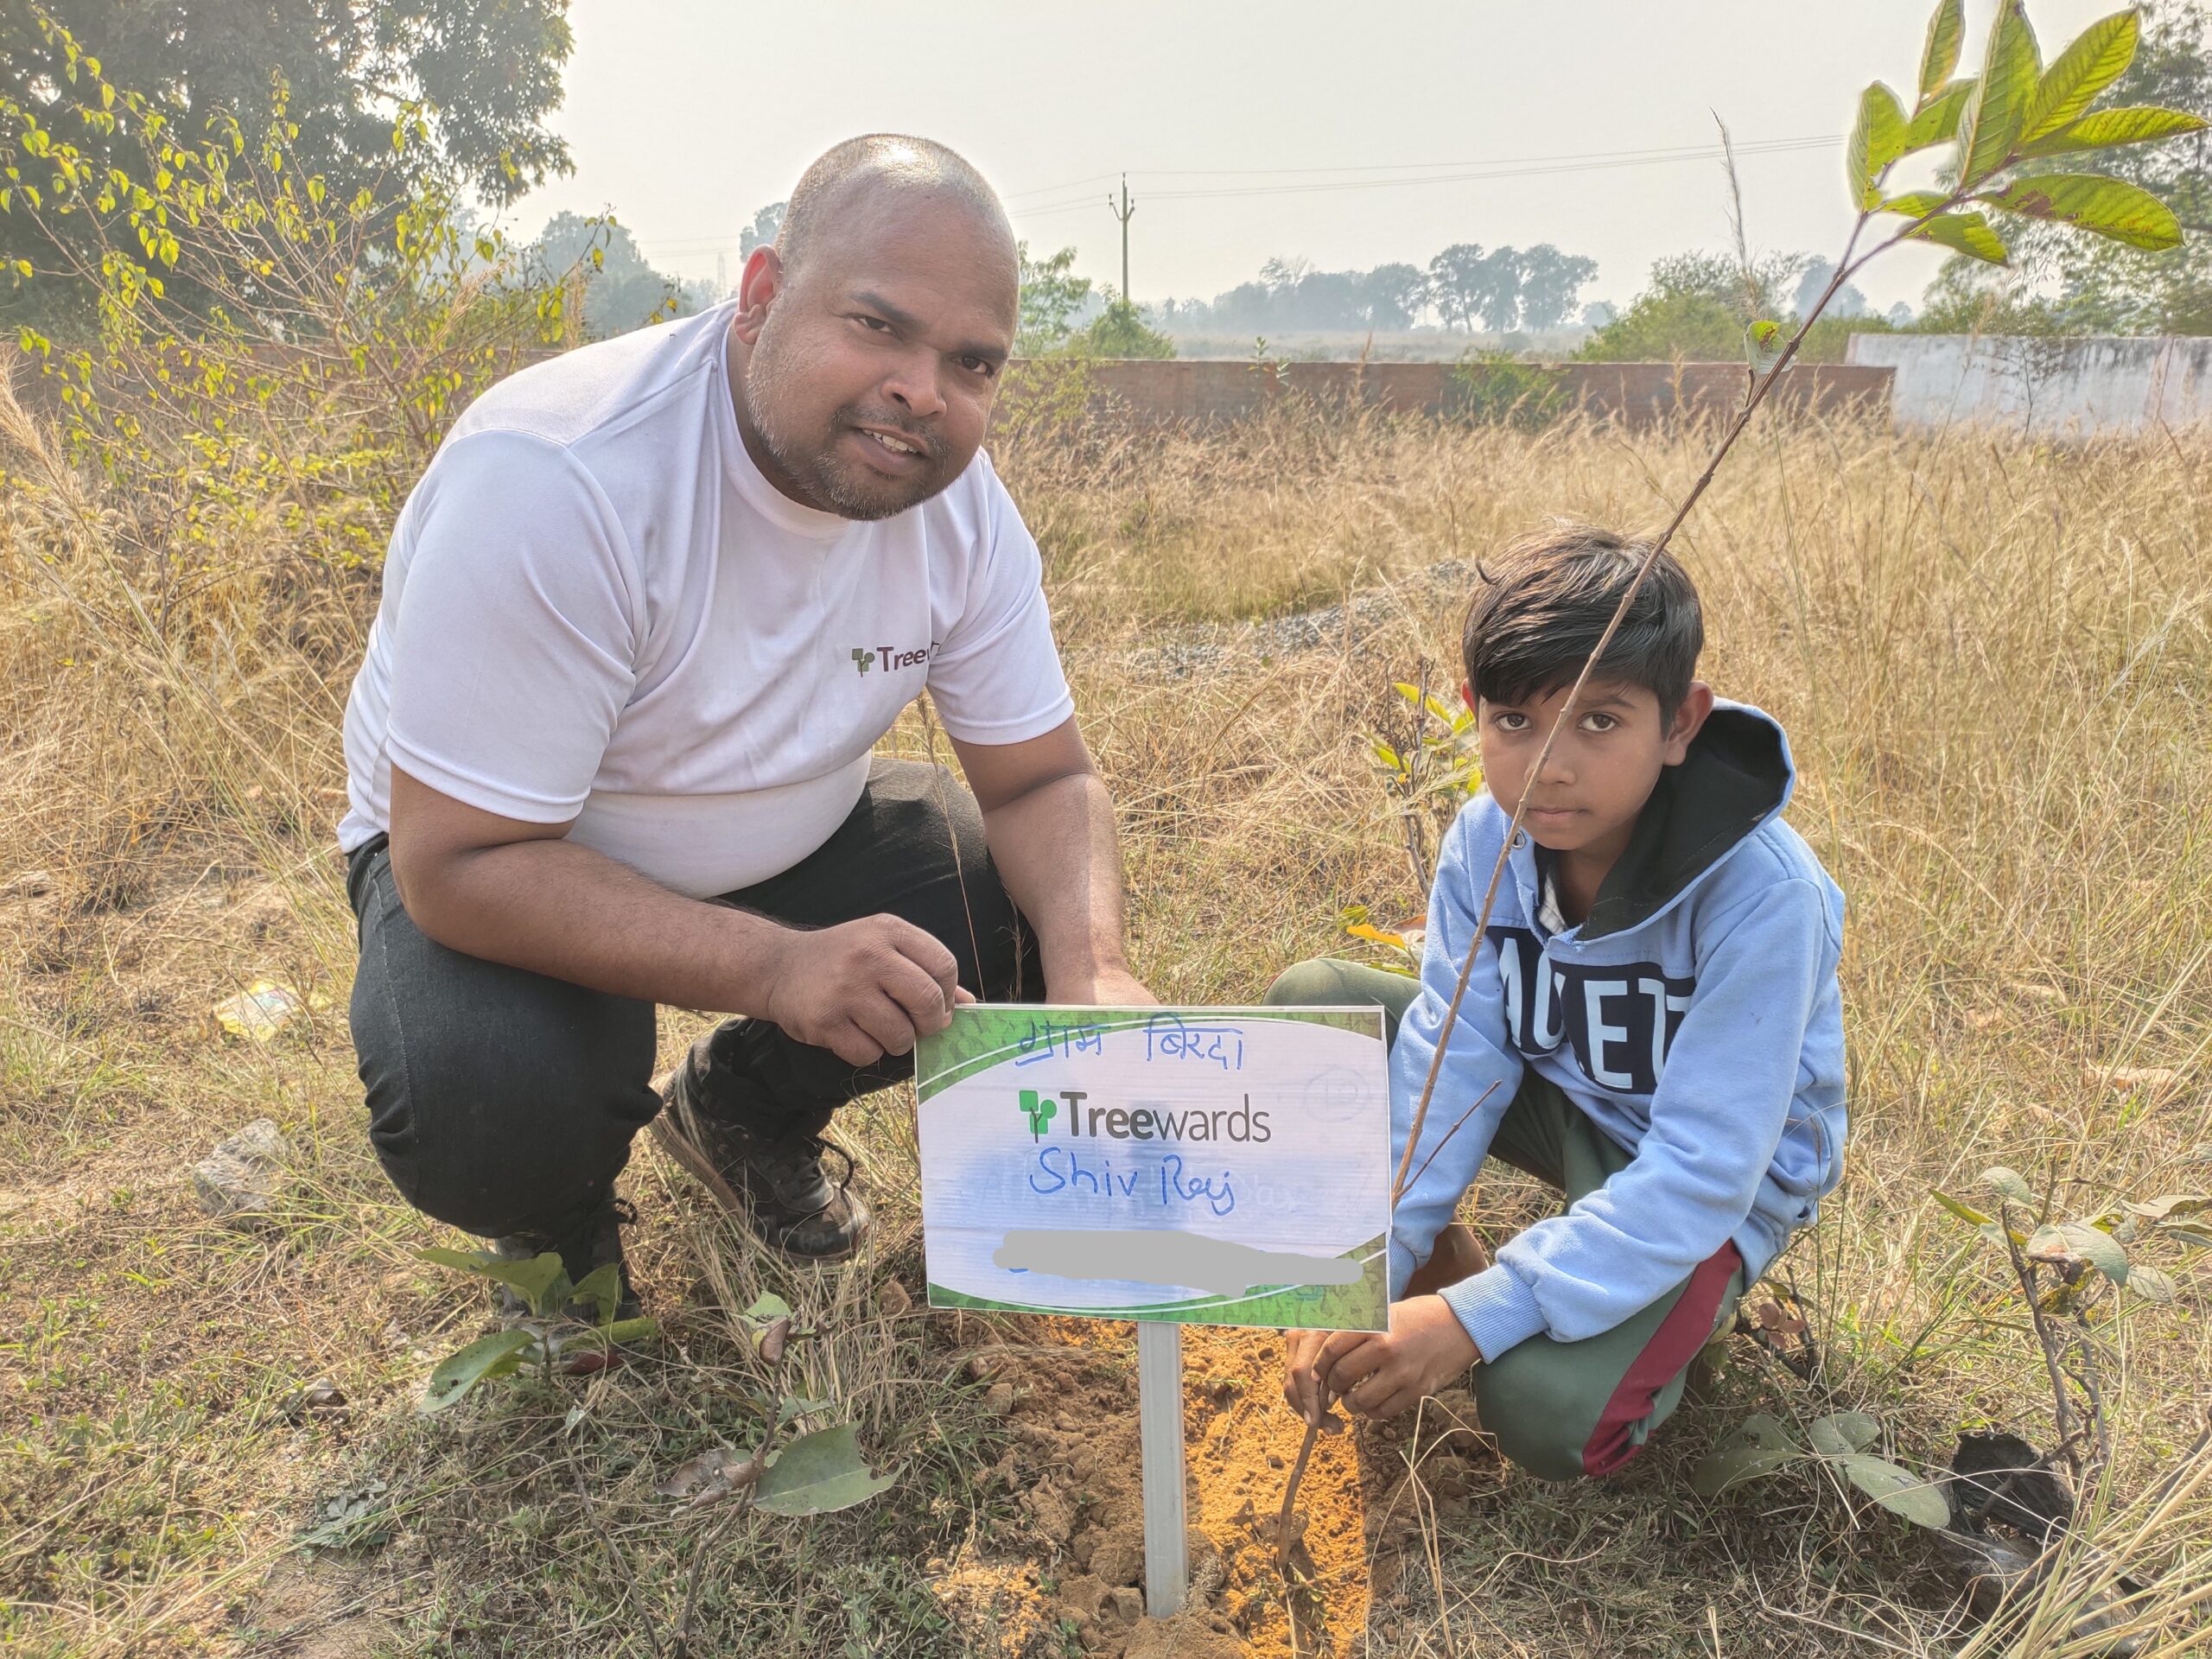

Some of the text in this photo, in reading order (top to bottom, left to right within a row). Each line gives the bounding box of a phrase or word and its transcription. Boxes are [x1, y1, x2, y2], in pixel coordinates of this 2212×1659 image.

[876, 645, 931, 672] Tree
[1059, 1090, 1272, 1144] Treewards
[1028, 1146, 1138, 1197] Shiv
